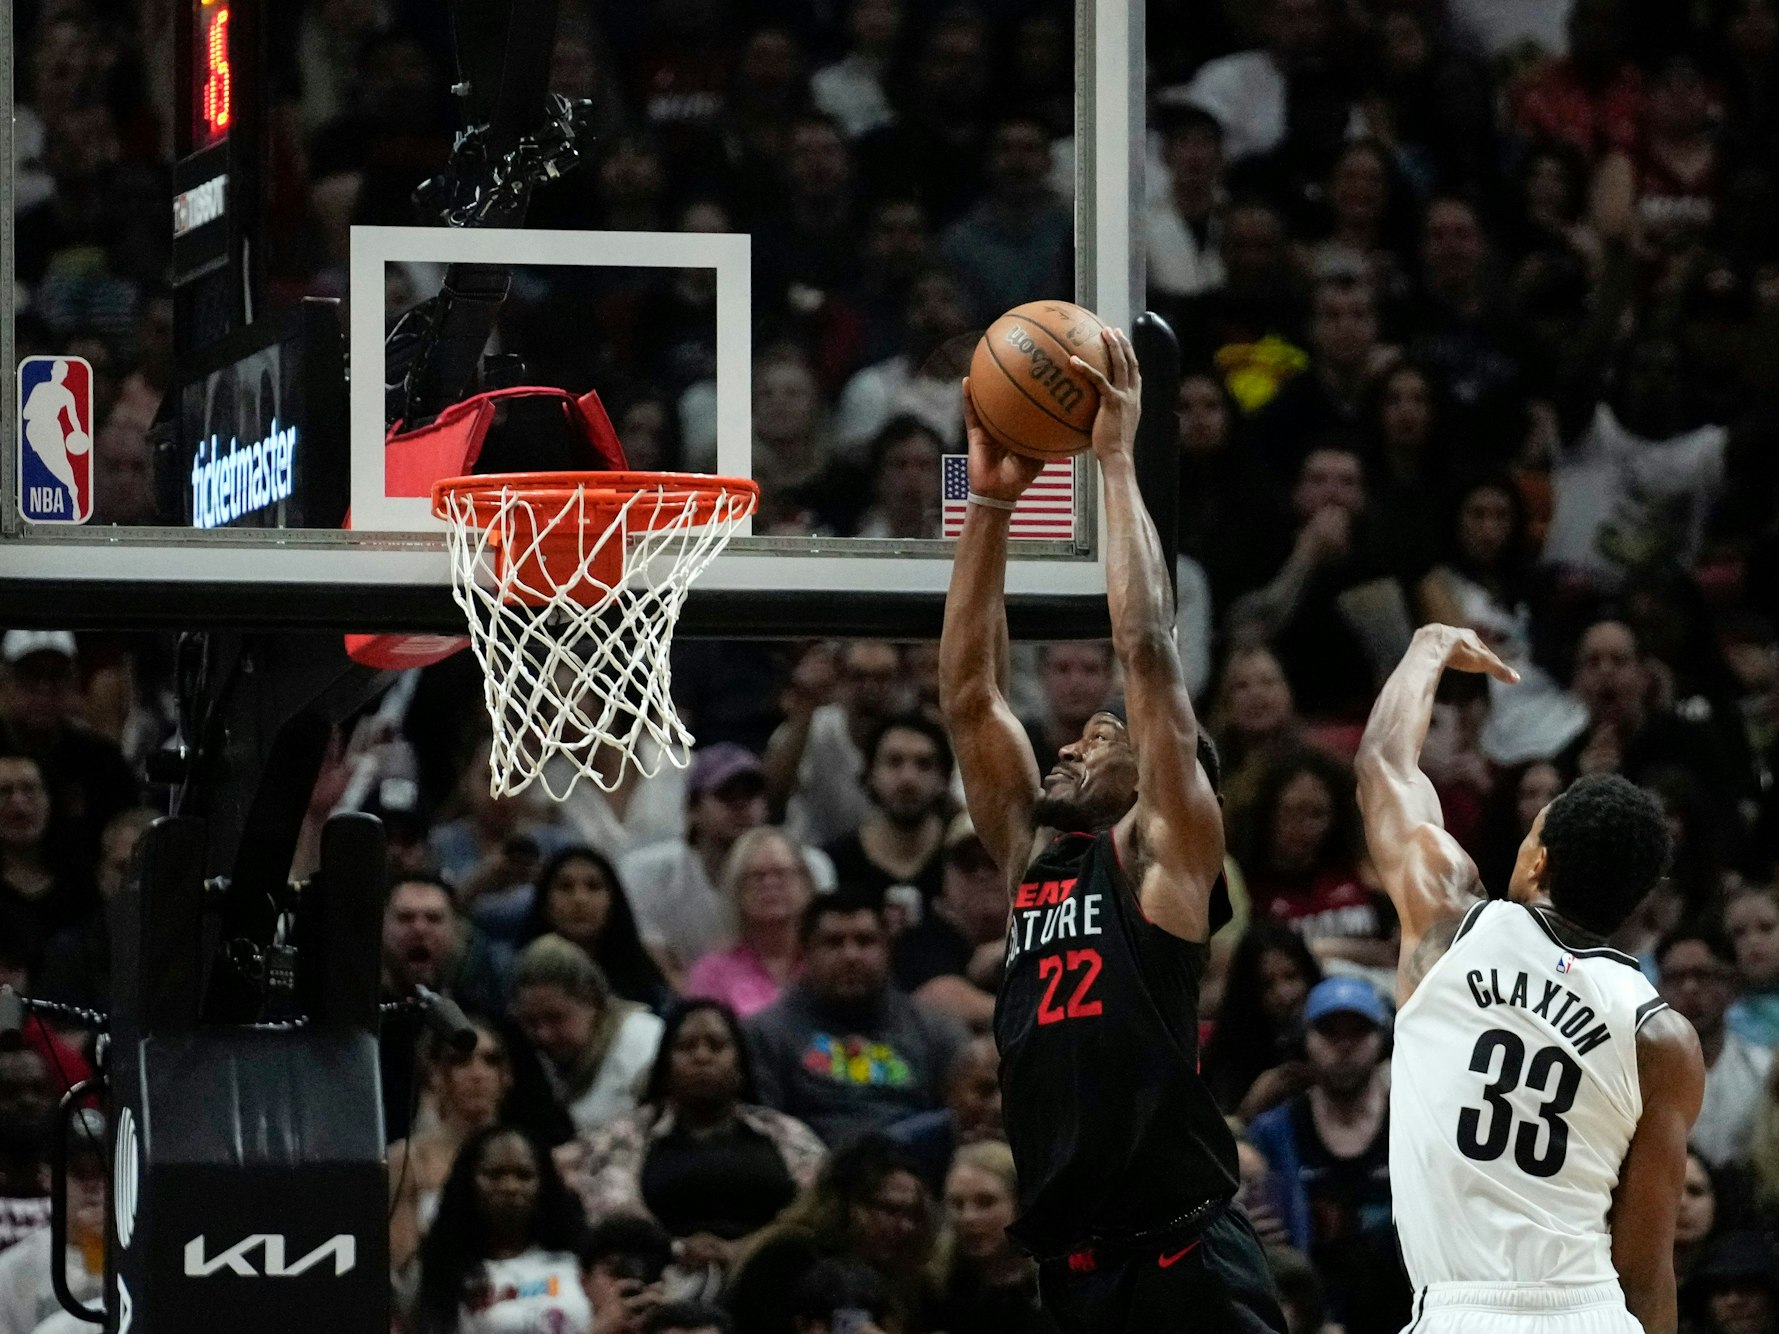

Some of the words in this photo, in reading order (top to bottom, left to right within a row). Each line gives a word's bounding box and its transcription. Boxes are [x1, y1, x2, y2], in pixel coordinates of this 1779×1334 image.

[1005, 324, 1085, 415] Wilson
[30, 486, 65, 513] NBA
[192, 416, 297, 529] ticketmaster
[1014, 878, 1079, 908] EAT
[1037, 948, 1103, 1025] 22
[1466, 968, 1612, 1057] CLAXTON
[1456, 1028, 1583, 1178] 33
[184, 1233, 356, 1278] KIA
